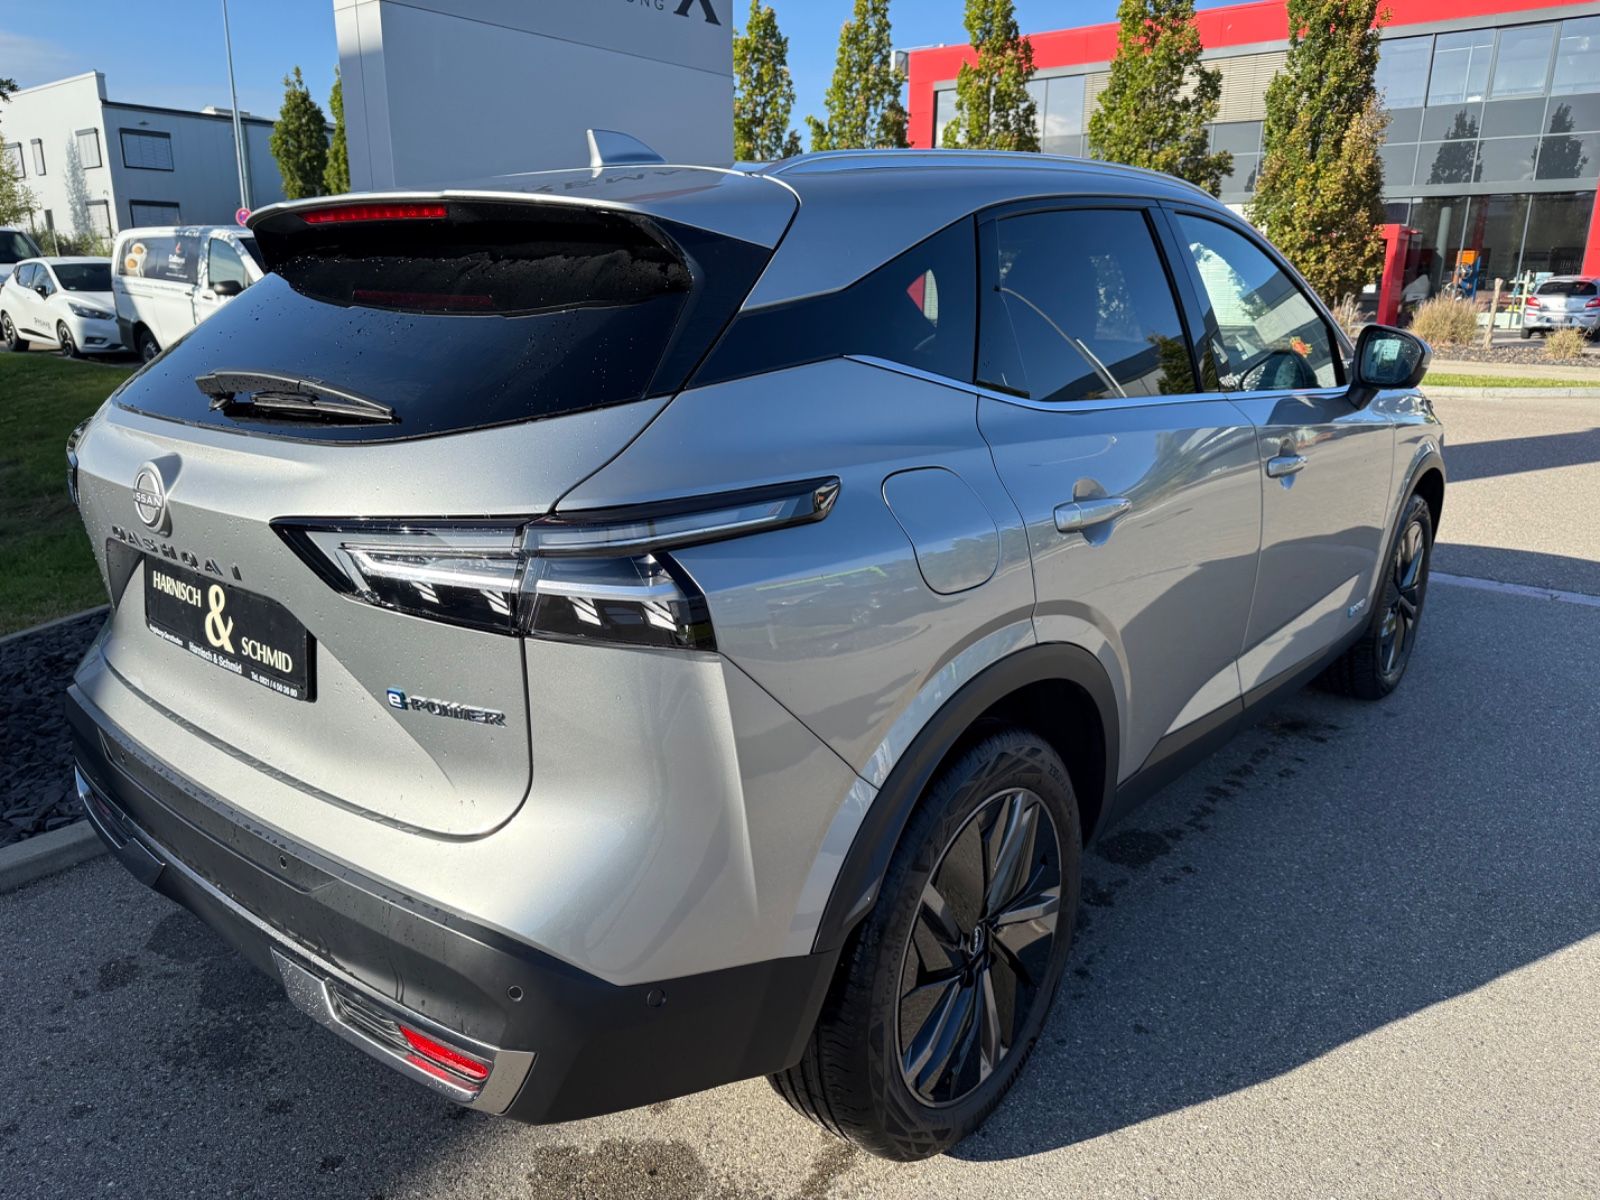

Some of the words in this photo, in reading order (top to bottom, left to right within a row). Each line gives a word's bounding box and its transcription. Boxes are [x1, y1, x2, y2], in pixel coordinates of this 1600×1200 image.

[133, 490, 162, 509] SSAN
[111, 525, 242, 581] QASHQAI
[153, 570, 202, 607] HARNISCH
[205, 584, 235, 654] &
[241, 636, 293, 673] SCHMID
